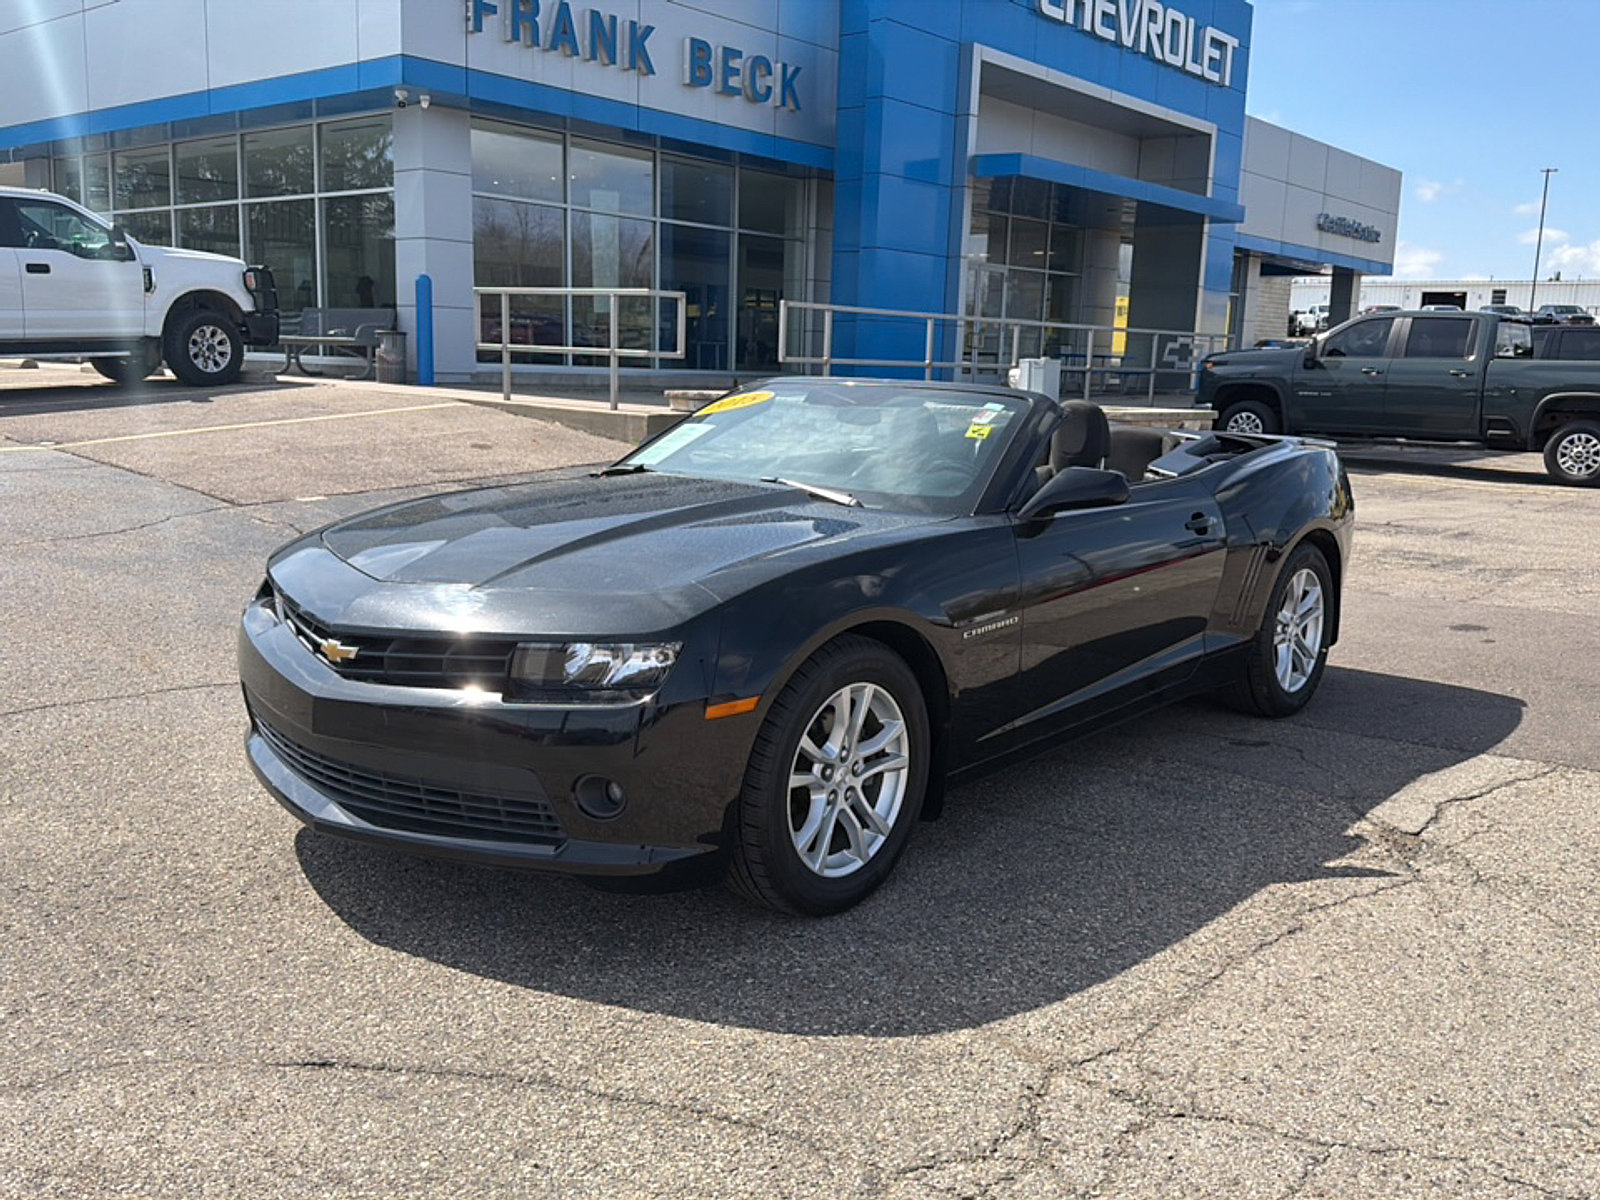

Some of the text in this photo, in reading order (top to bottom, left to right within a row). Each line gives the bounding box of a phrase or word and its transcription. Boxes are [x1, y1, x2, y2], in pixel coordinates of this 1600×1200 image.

[467, 0, 802, 111] FRANK BECK
[963, 616, 1019, 639] CAMARO
